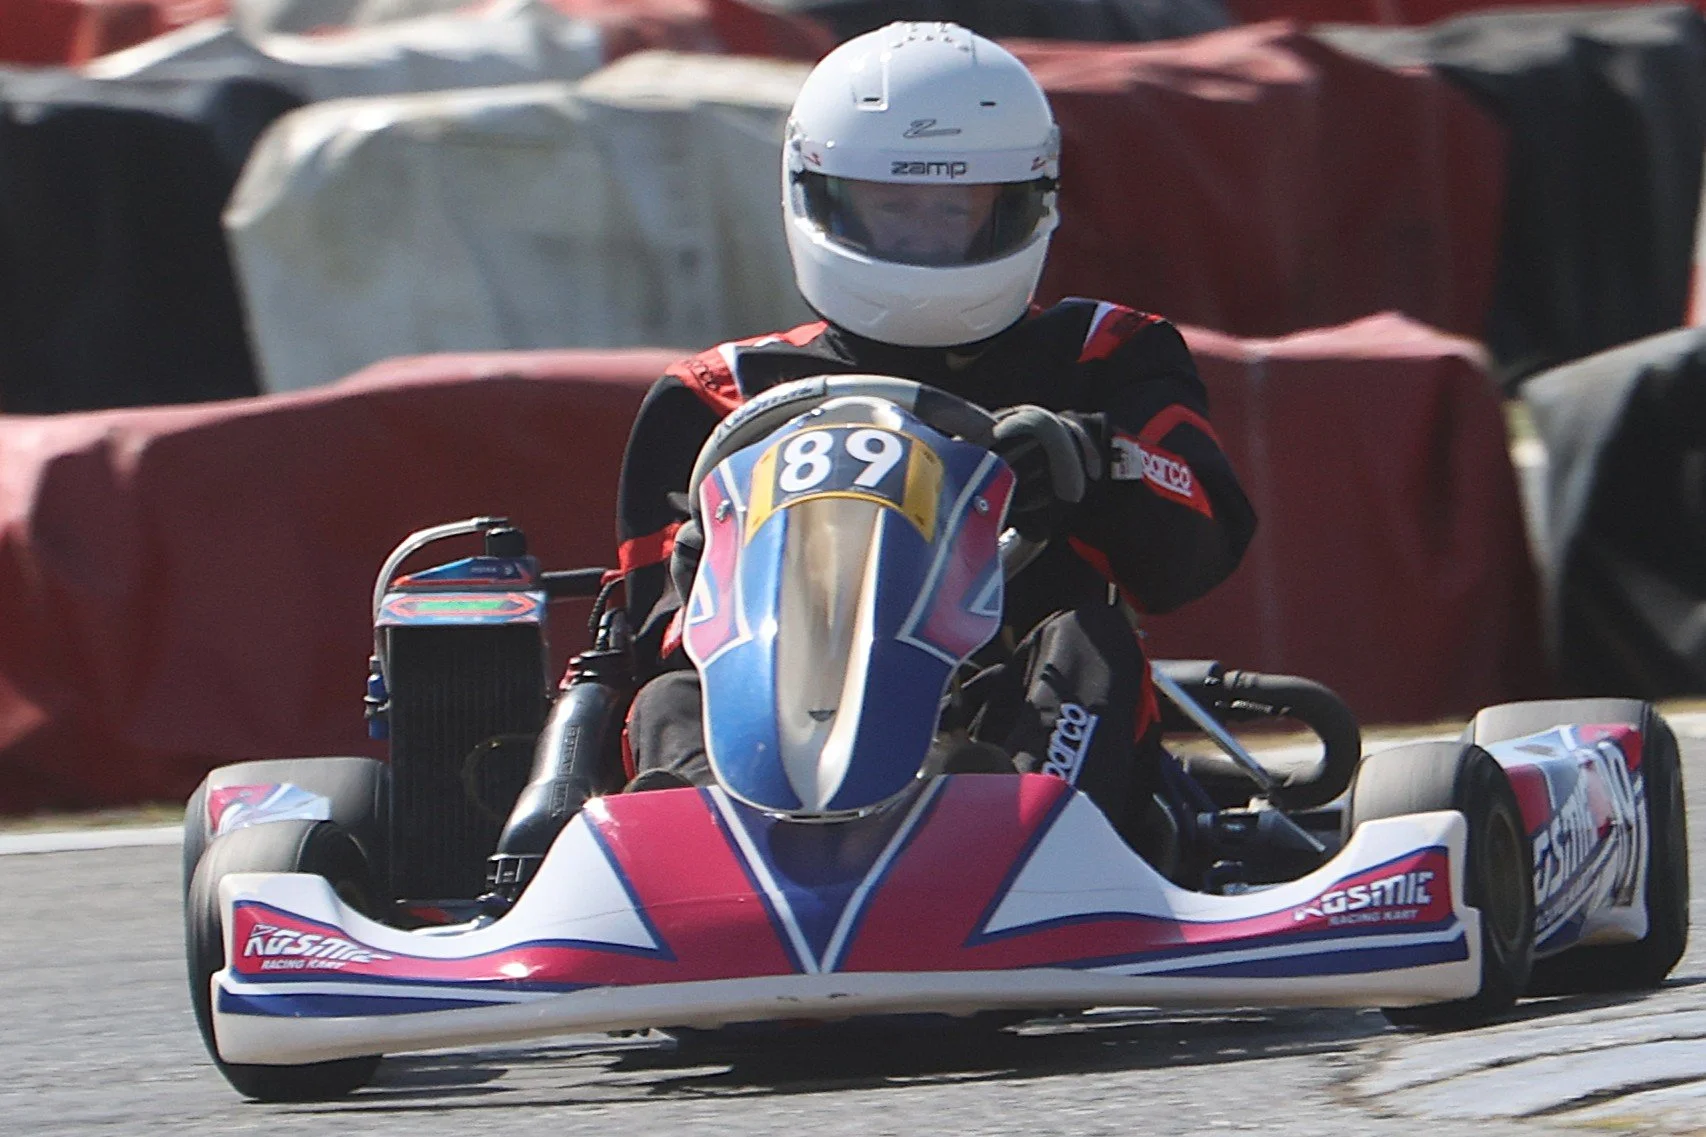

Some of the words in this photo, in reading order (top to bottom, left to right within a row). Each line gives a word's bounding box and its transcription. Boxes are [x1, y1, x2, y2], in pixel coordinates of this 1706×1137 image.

[891, 161, 968, 178] zamp
[779, 428, 903, 492] 89
[1293, 871, 1434, 921] KOSMIC
[244, 924, 392, 963] KOSMIC
[260, 959, 305, 970] RACING
[305, 959, 346, 970] KART
